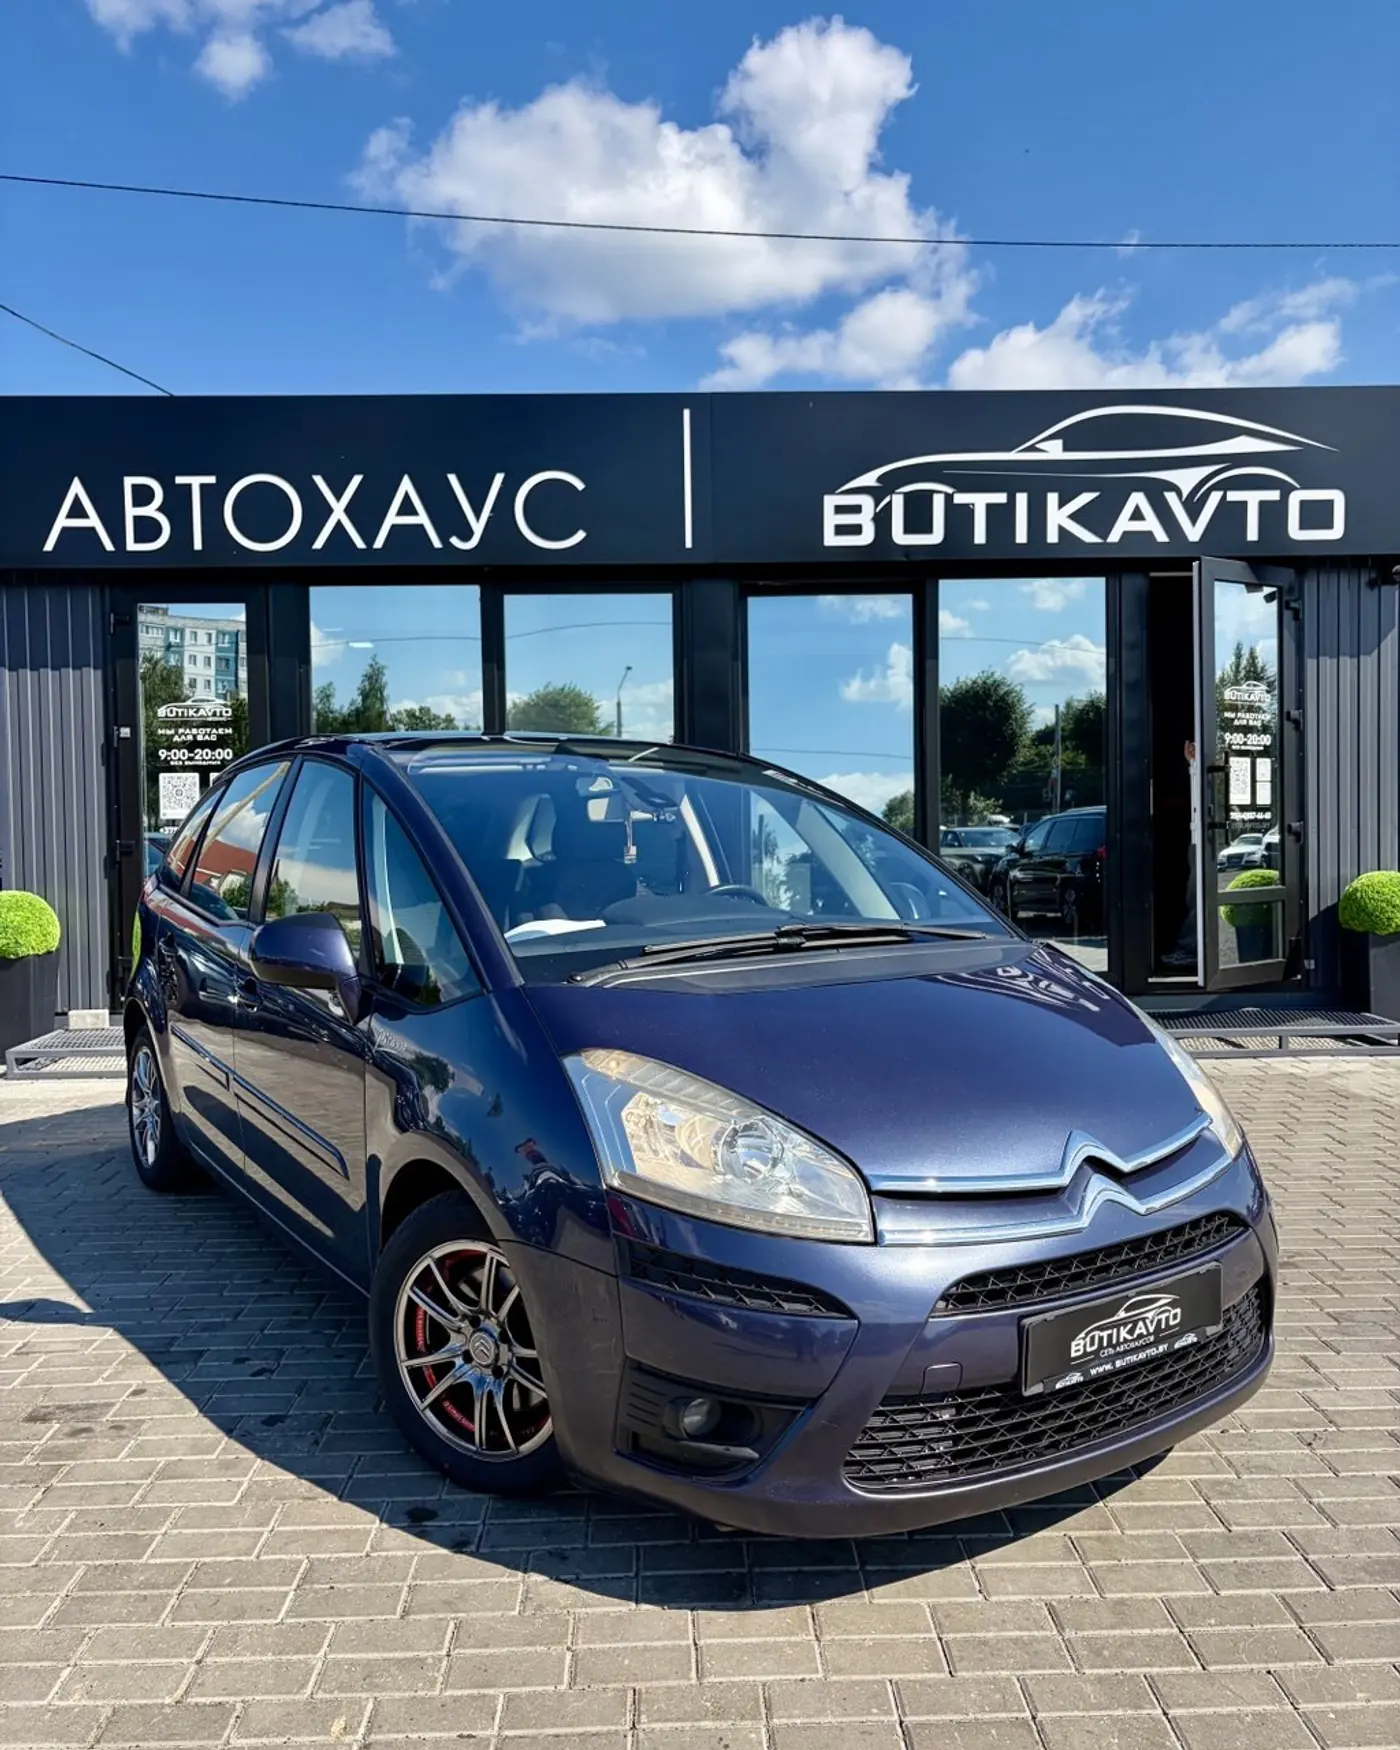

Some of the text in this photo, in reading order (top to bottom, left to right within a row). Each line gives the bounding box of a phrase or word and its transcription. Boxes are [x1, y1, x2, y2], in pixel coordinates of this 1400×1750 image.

[42, 470, 588, 553] АВТОХАУС
[822, 487, 1346, 547] BUTIKAVTO
[157, 708, 232, 717] BUTIKAVTO
[158, 748, 233, 760] 9:00-20:00
[1224, 732, 1272, 746] 9:00-20:00
[1070, 1308, 1181, 1358] BUTIKAVTO
